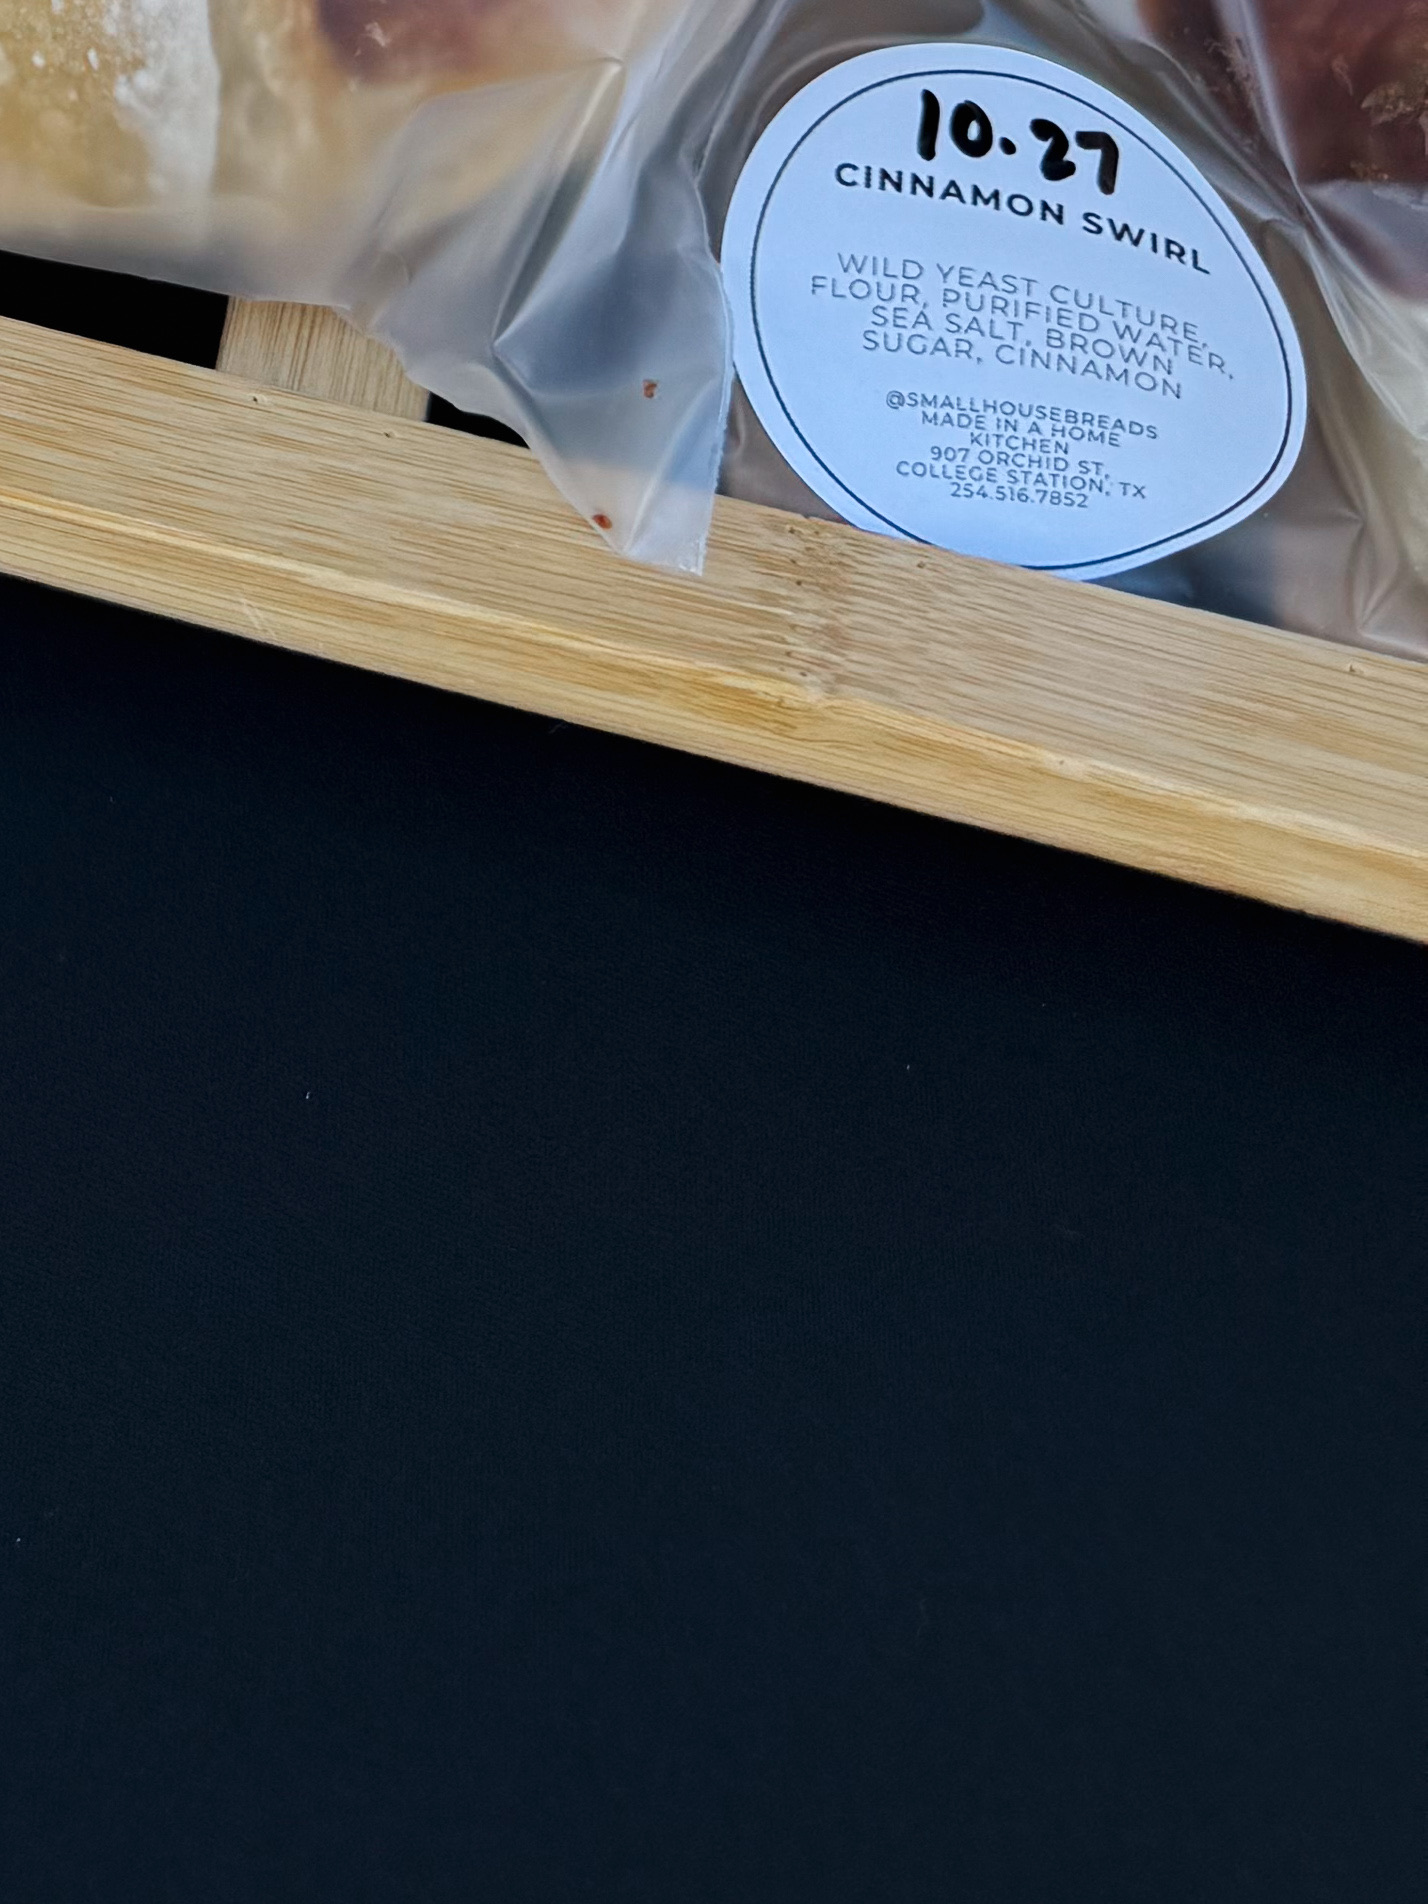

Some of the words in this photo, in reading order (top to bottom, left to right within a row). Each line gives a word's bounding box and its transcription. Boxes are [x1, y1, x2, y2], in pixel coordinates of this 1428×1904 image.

[917, 89, 1119, 195] 10.27
[835, 163, 1065, 226] CINNAMON
[1082, 212, 1211, 275] SWIRL
[812, 276, 928, 309] FLOUR,
[943, 290, 1099, 332] PURIFIED
[1112, 321, 1234, 380] WATER,
[838, 253, 924, 280] WILD
[936, 264, 1039, 295] YEAST
[1050, 285, 1208, 348] CULTURE,
[863, 330, 984, 365] SUGAR,
[995, 347, 1181, 399] CINNAMON
[871, 306, 934, 330] SEA
[945, 314, 1032, 346] SALT,
[1047, 330, 1173, 375] BROWN
[886, 390, 1158, 439] @SMALLHOUSEBREADS
[922, 411, 986, 430] MADE
[996, 418, 1017, 432] IN
[1028, 422, 1042, 435] A
[1051, 424, 1121, 447] HOME
[970, 432, 1069, 454] KITCHEN
[896, 461, 998, 483] COLLEGE
[1007, 470, 1111, 496] STATION,
[1119, 482, 1146, 499] TX
[930, 447, 969, 462] 907
[978, 449, 1069, 472] ORCHID
[951, 482, 1088, 508] 254.516.7852
